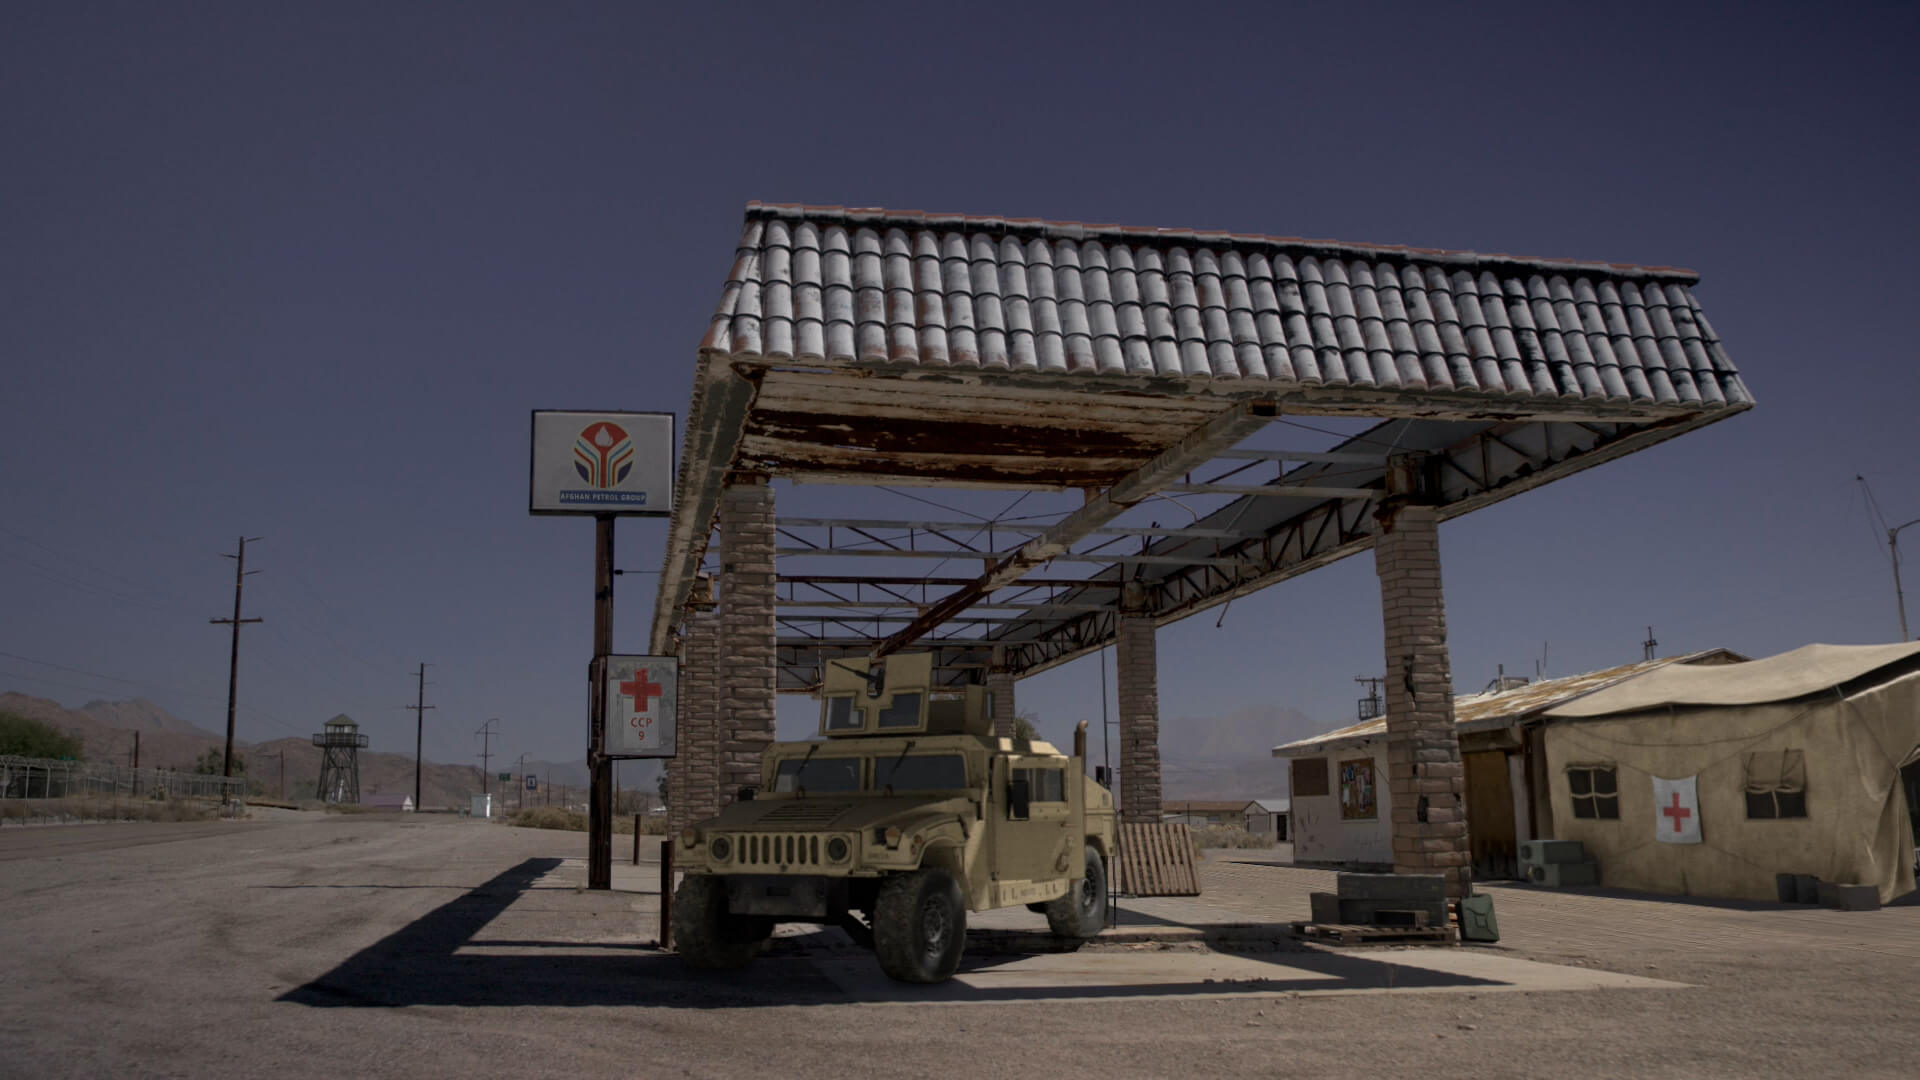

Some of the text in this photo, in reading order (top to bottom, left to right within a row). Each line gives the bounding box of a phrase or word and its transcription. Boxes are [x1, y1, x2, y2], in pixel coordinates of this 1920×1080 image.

[560, 493, 646, 502] AFGHAN PETROL GROUP
[631, 717, 653, 728] CCP
[638, 730, 646, 741] 9
